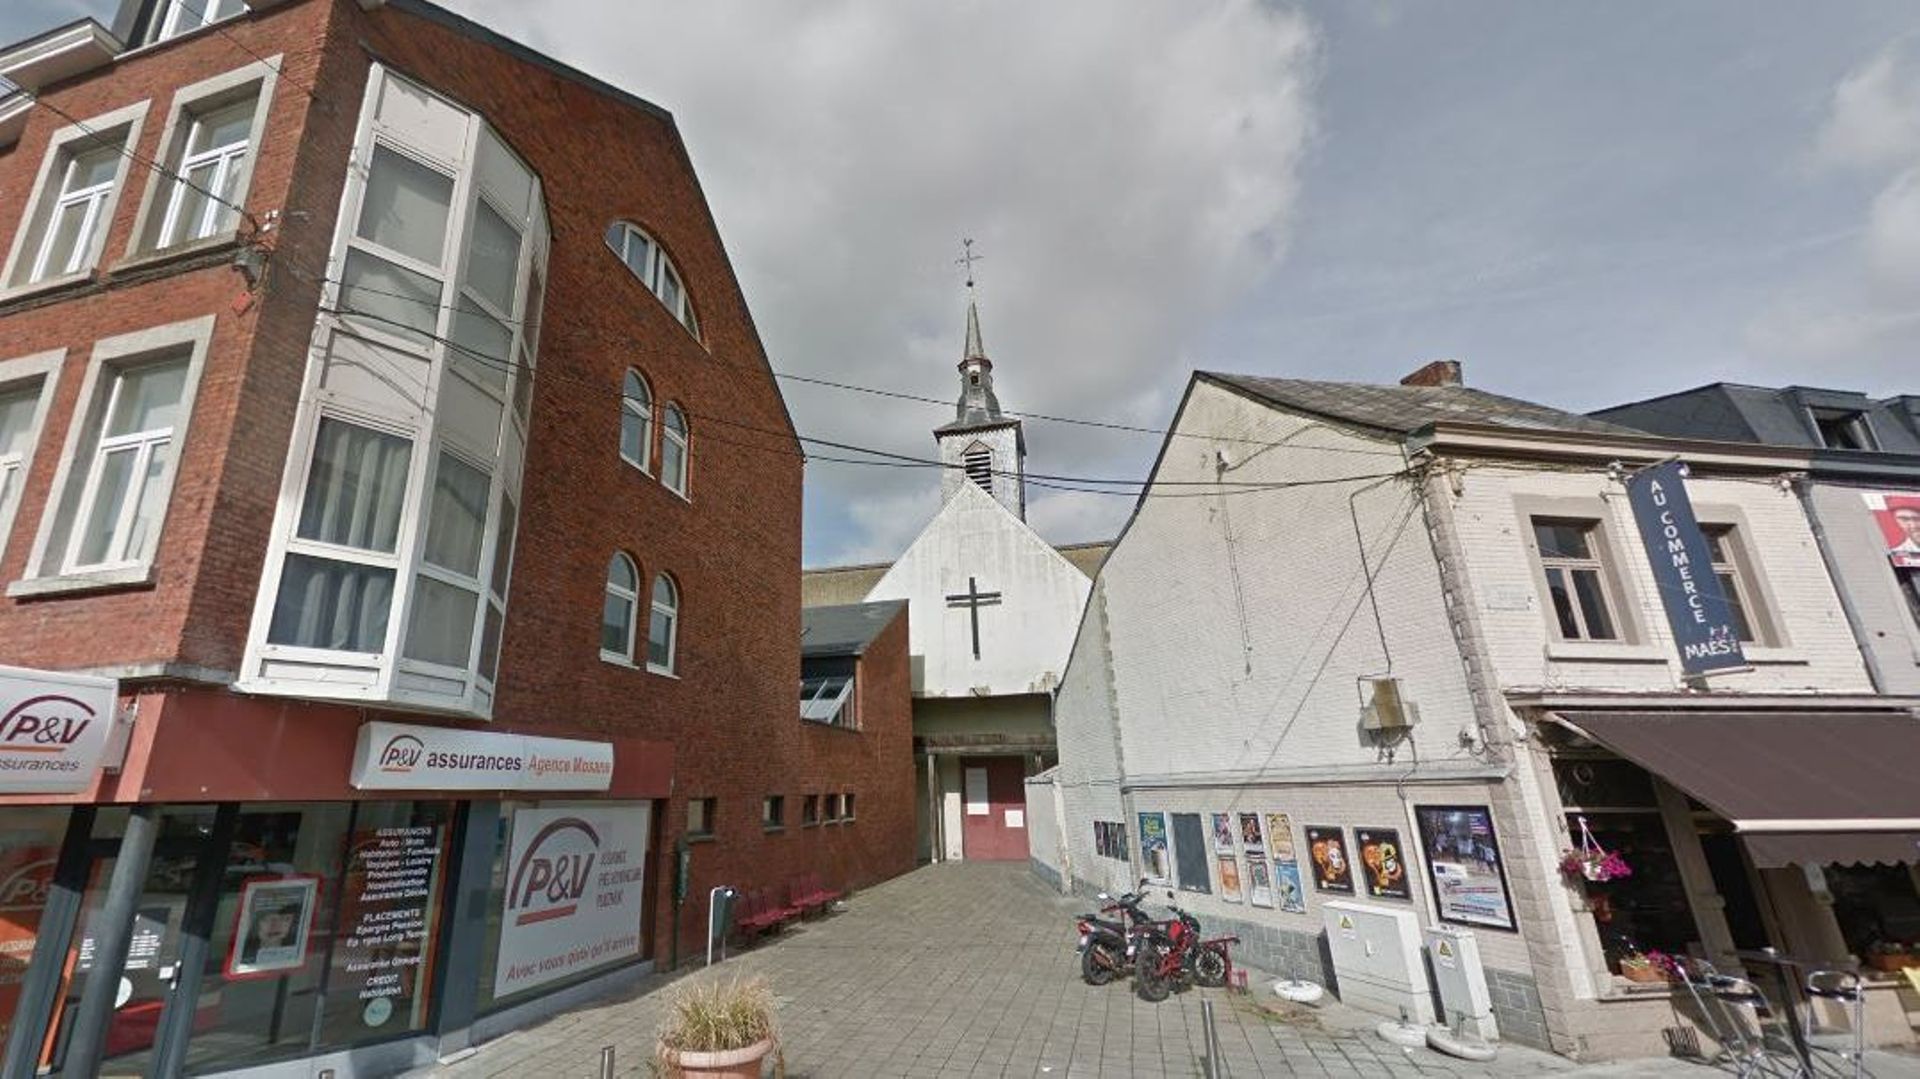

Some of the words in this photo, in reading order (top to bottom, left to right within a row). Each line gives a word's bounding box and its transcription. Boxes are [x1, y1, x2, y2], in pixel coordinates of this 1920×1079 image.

[1661, 511, 1706, 623] COMMERCE
[5, 715, 91, 743] P&V
[387, 747, 422, 767] P&V
[427, 751, 522, 771] assurances
[528, 755, 571, 777] Agence
[521, 852, 597, 909] P&V
